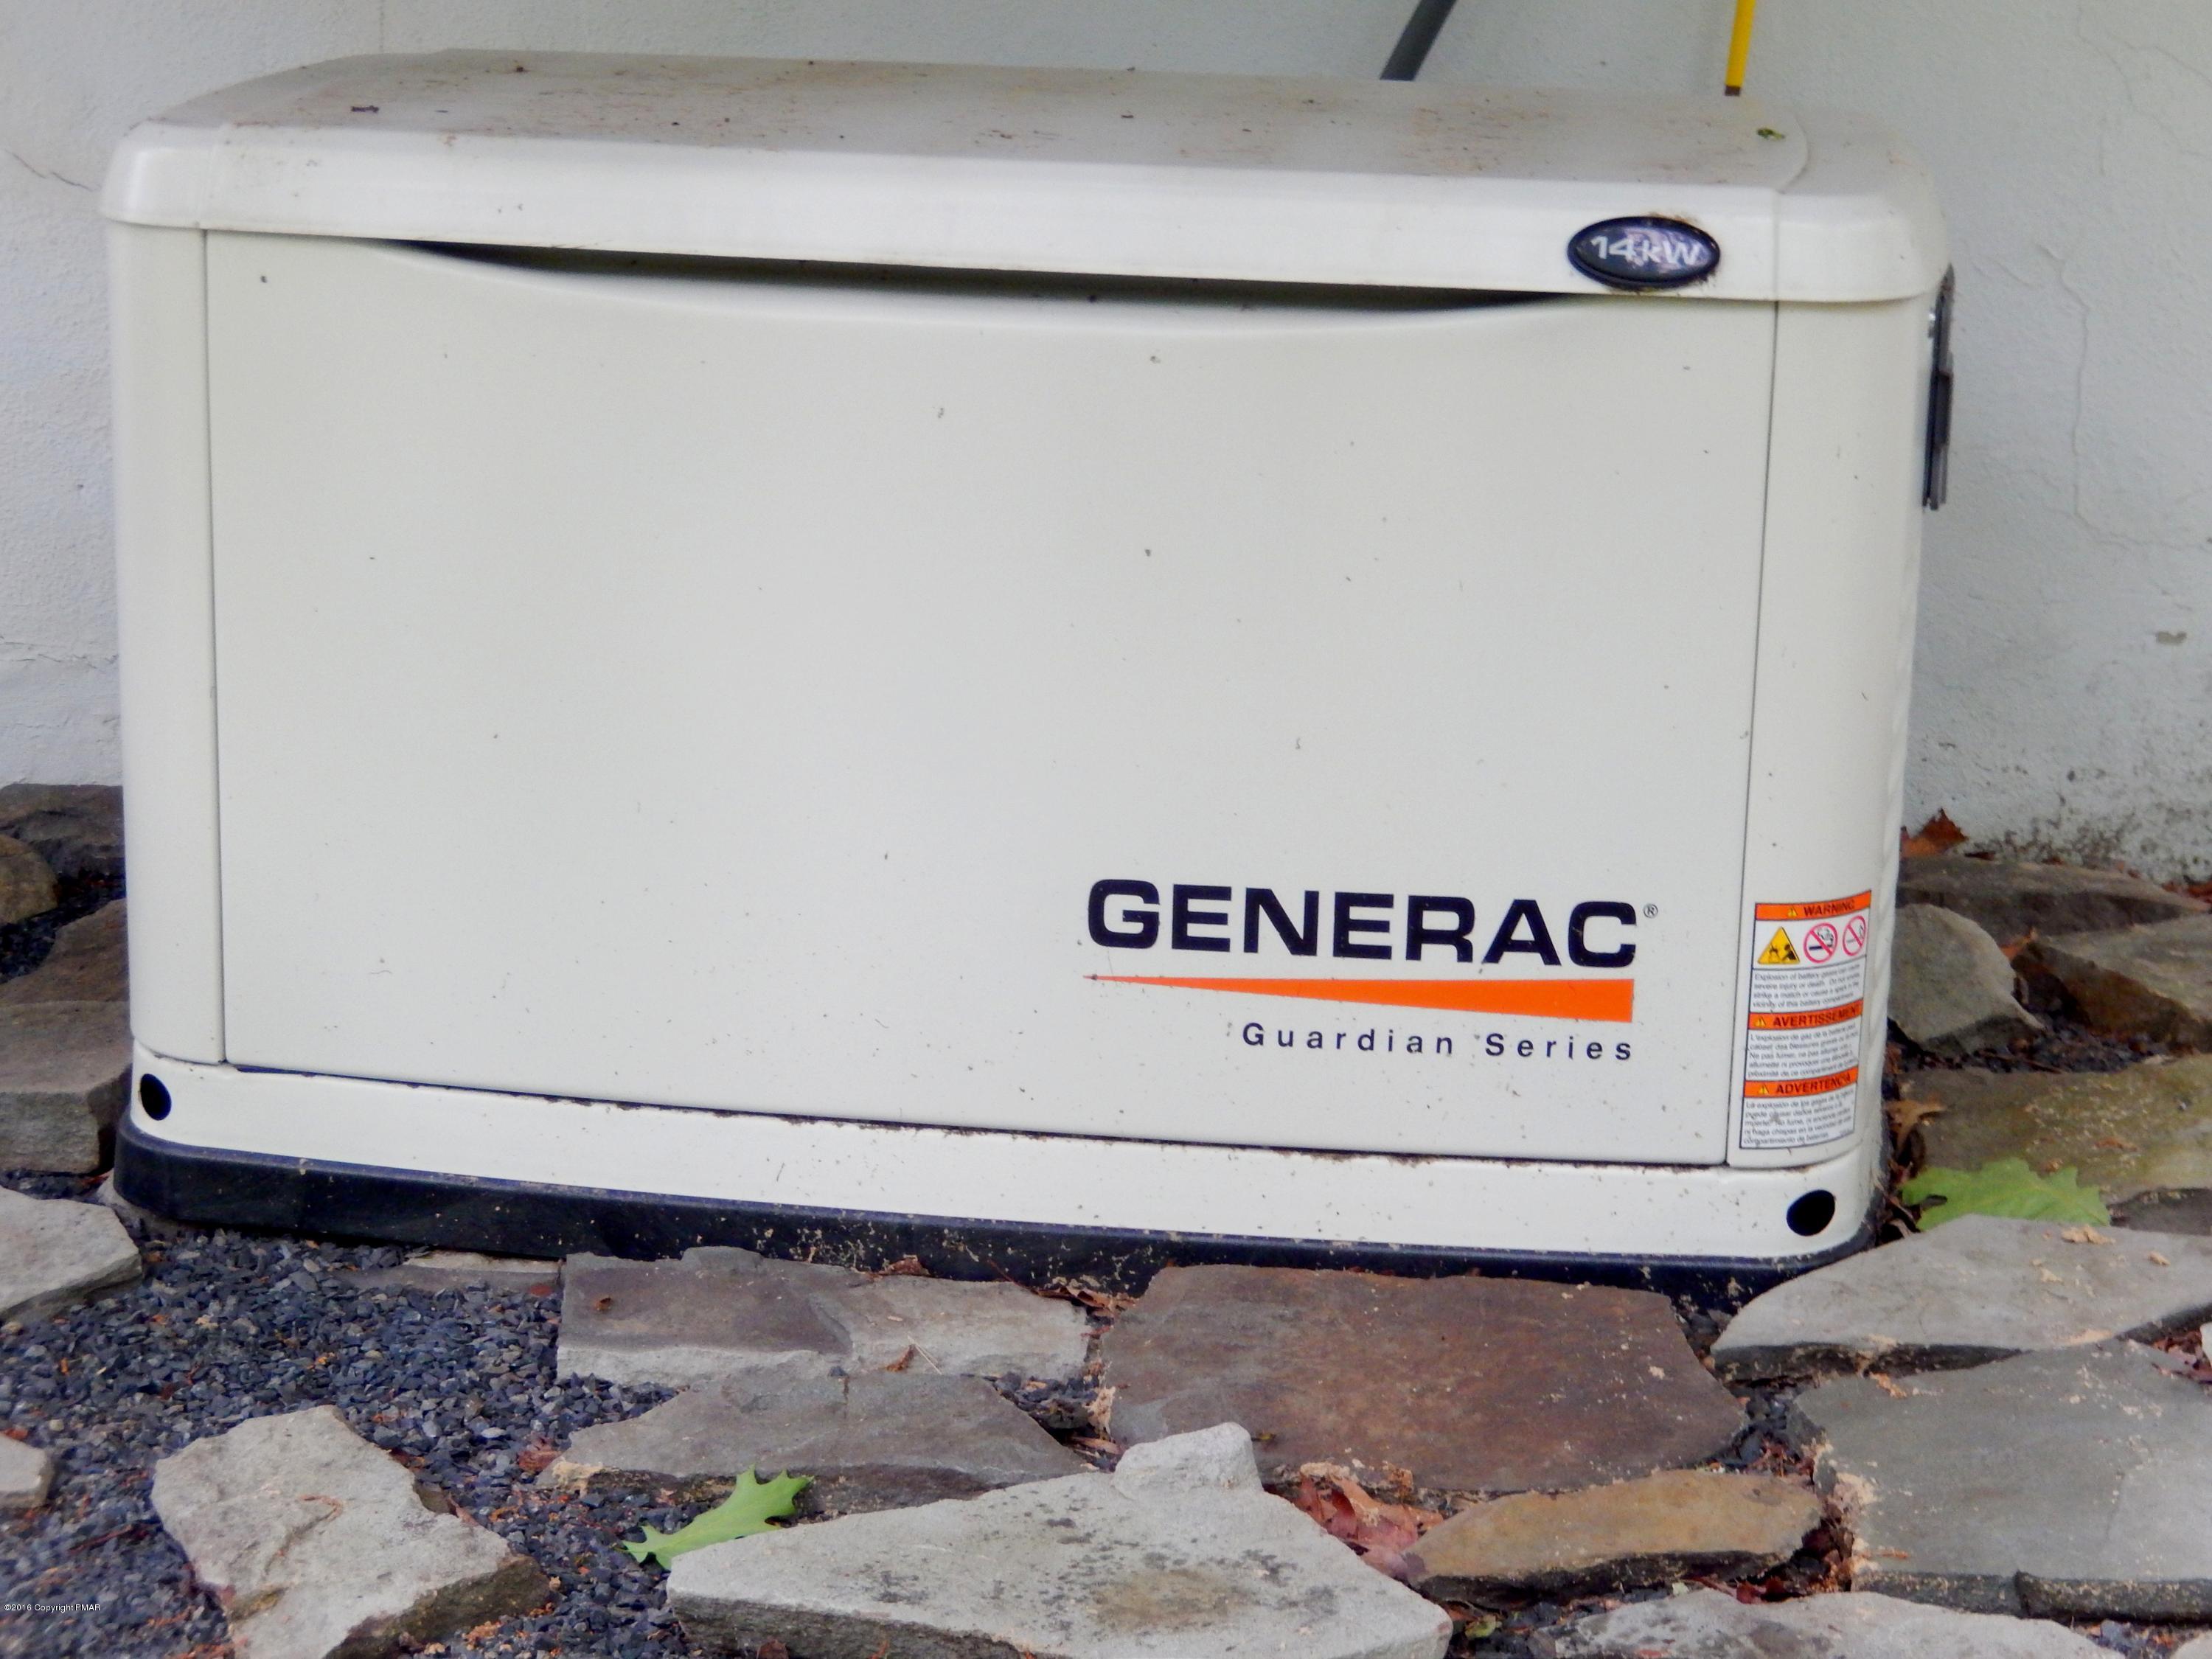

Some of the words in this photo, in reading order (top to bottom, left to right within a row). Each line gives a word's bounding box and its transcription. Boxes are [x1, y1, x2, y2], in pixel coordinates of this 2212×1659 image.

[1590, 235, 1701, 266] 14kW
[1803, 899, 1855, 917] WARNING
[1087, 878, 1637, 969] GENERAC
[1773, 1004, 1860, 1027] AVERTISSEMENT
[1242, 1022, 1453, 1056] Guardian
[1484, 1034, 1632, 1061] Series
[1775, 1074, 1851, 1094] ADVERTENCIA
